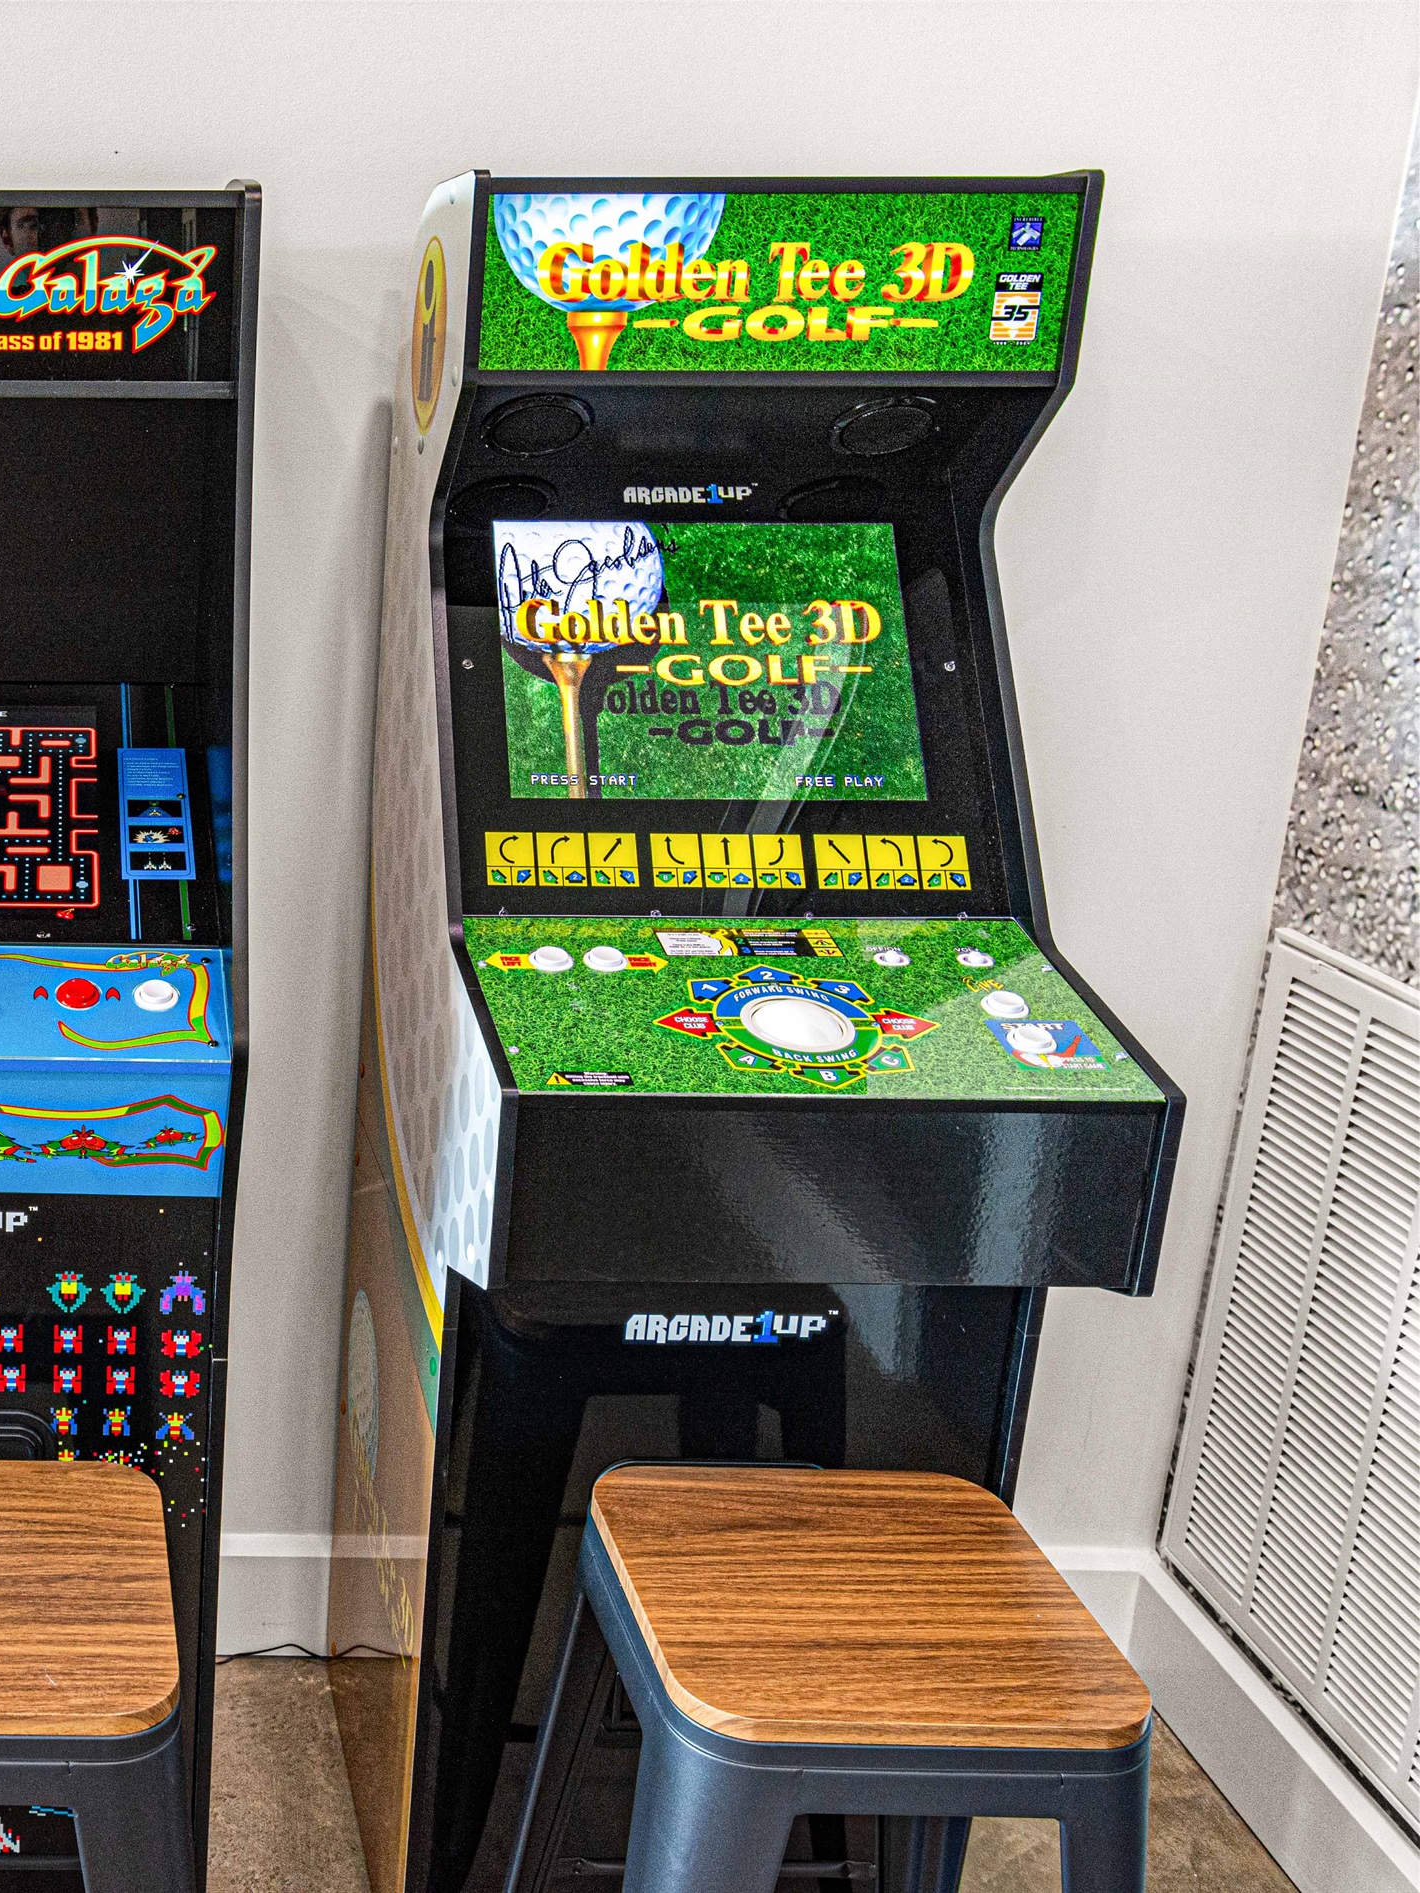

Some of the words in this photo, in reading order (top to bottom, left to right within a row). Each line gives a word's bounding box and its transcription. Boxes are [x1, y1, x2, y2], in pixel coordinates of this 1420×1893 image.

[537, 241, 751, 302] Golden
[770, 242, 866, 302] Tee
[883, 242, 975, 302] 3D
[999, 274, 1041, 283] GOLDEN
[1003, 305, 1030, 321] 35
[682, 306, 897, 342] GOLF
[39, 331, 62, 352] of
[66, 331, 123, 352] 1981
[516, 599, 689, 645] Golden
[699, 600, 791, 645] Tee
[803, 600, 882, 646] 3D
[655, 655, 832, 685] GOLF
[606, 681, 699, 716] olden
[707, 684, 776, 716] Tee
[531, 775, 579, 787] PRESS
[589, 775, 637, 787] START
[794, 775, 835, 788] FREE
[844, 775, 884, 788] PLAY
[761, 971, 776, 980] 2
[701, 983, 718, 992] 1
[733, 985, 783, 1002] FORWARD
[786, 986, 830, 1003] SWING
[834, 985, 851, 994] 3
[738, 1055, 756, 1066] A
[772, 1048, 813, 1063] BACK
[816, 1048, 857, 1063] SWING
[881, 1055, 902, 1067] C
[819, 1070, 838, 1081] B
